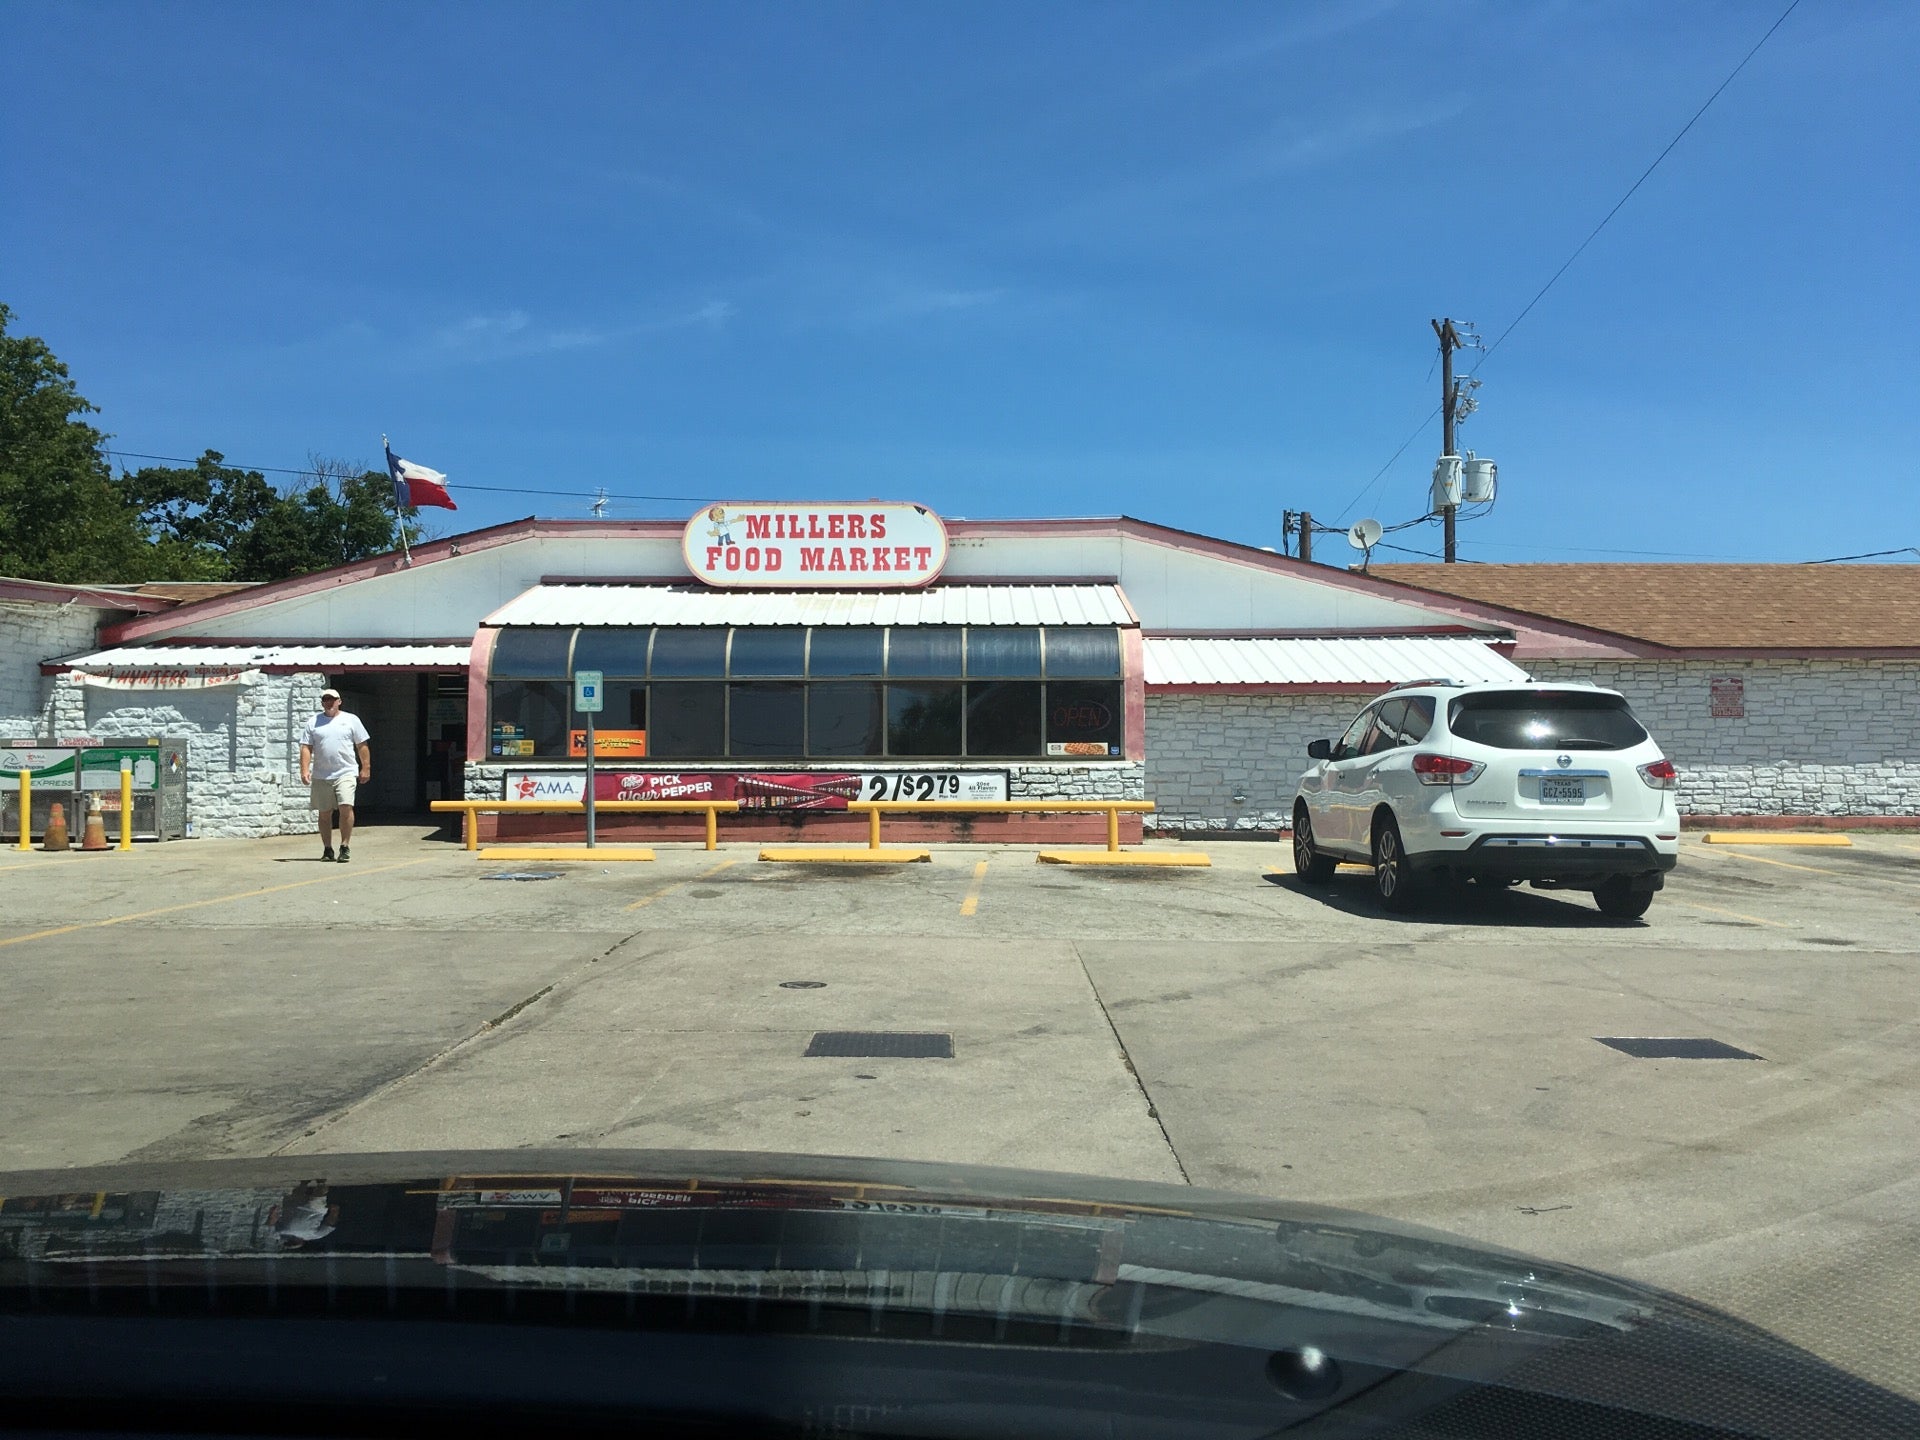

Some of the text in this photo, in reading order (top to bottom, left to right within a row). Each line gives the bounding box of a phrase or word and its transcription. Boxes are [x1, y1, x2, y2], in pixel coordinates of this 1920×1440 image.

[746, 514, 886, 539] MILLERS
[706, 546, 932, 572] FOOD MARKET
[116, 669, 189, 685] HUNTERS
[1053, 706, 1101, 728] OPEN
[519, 780, 574, 794] GAMA
[650, 774, 682, 788] PICK
[661, 781, 713, 798] PEPPER
